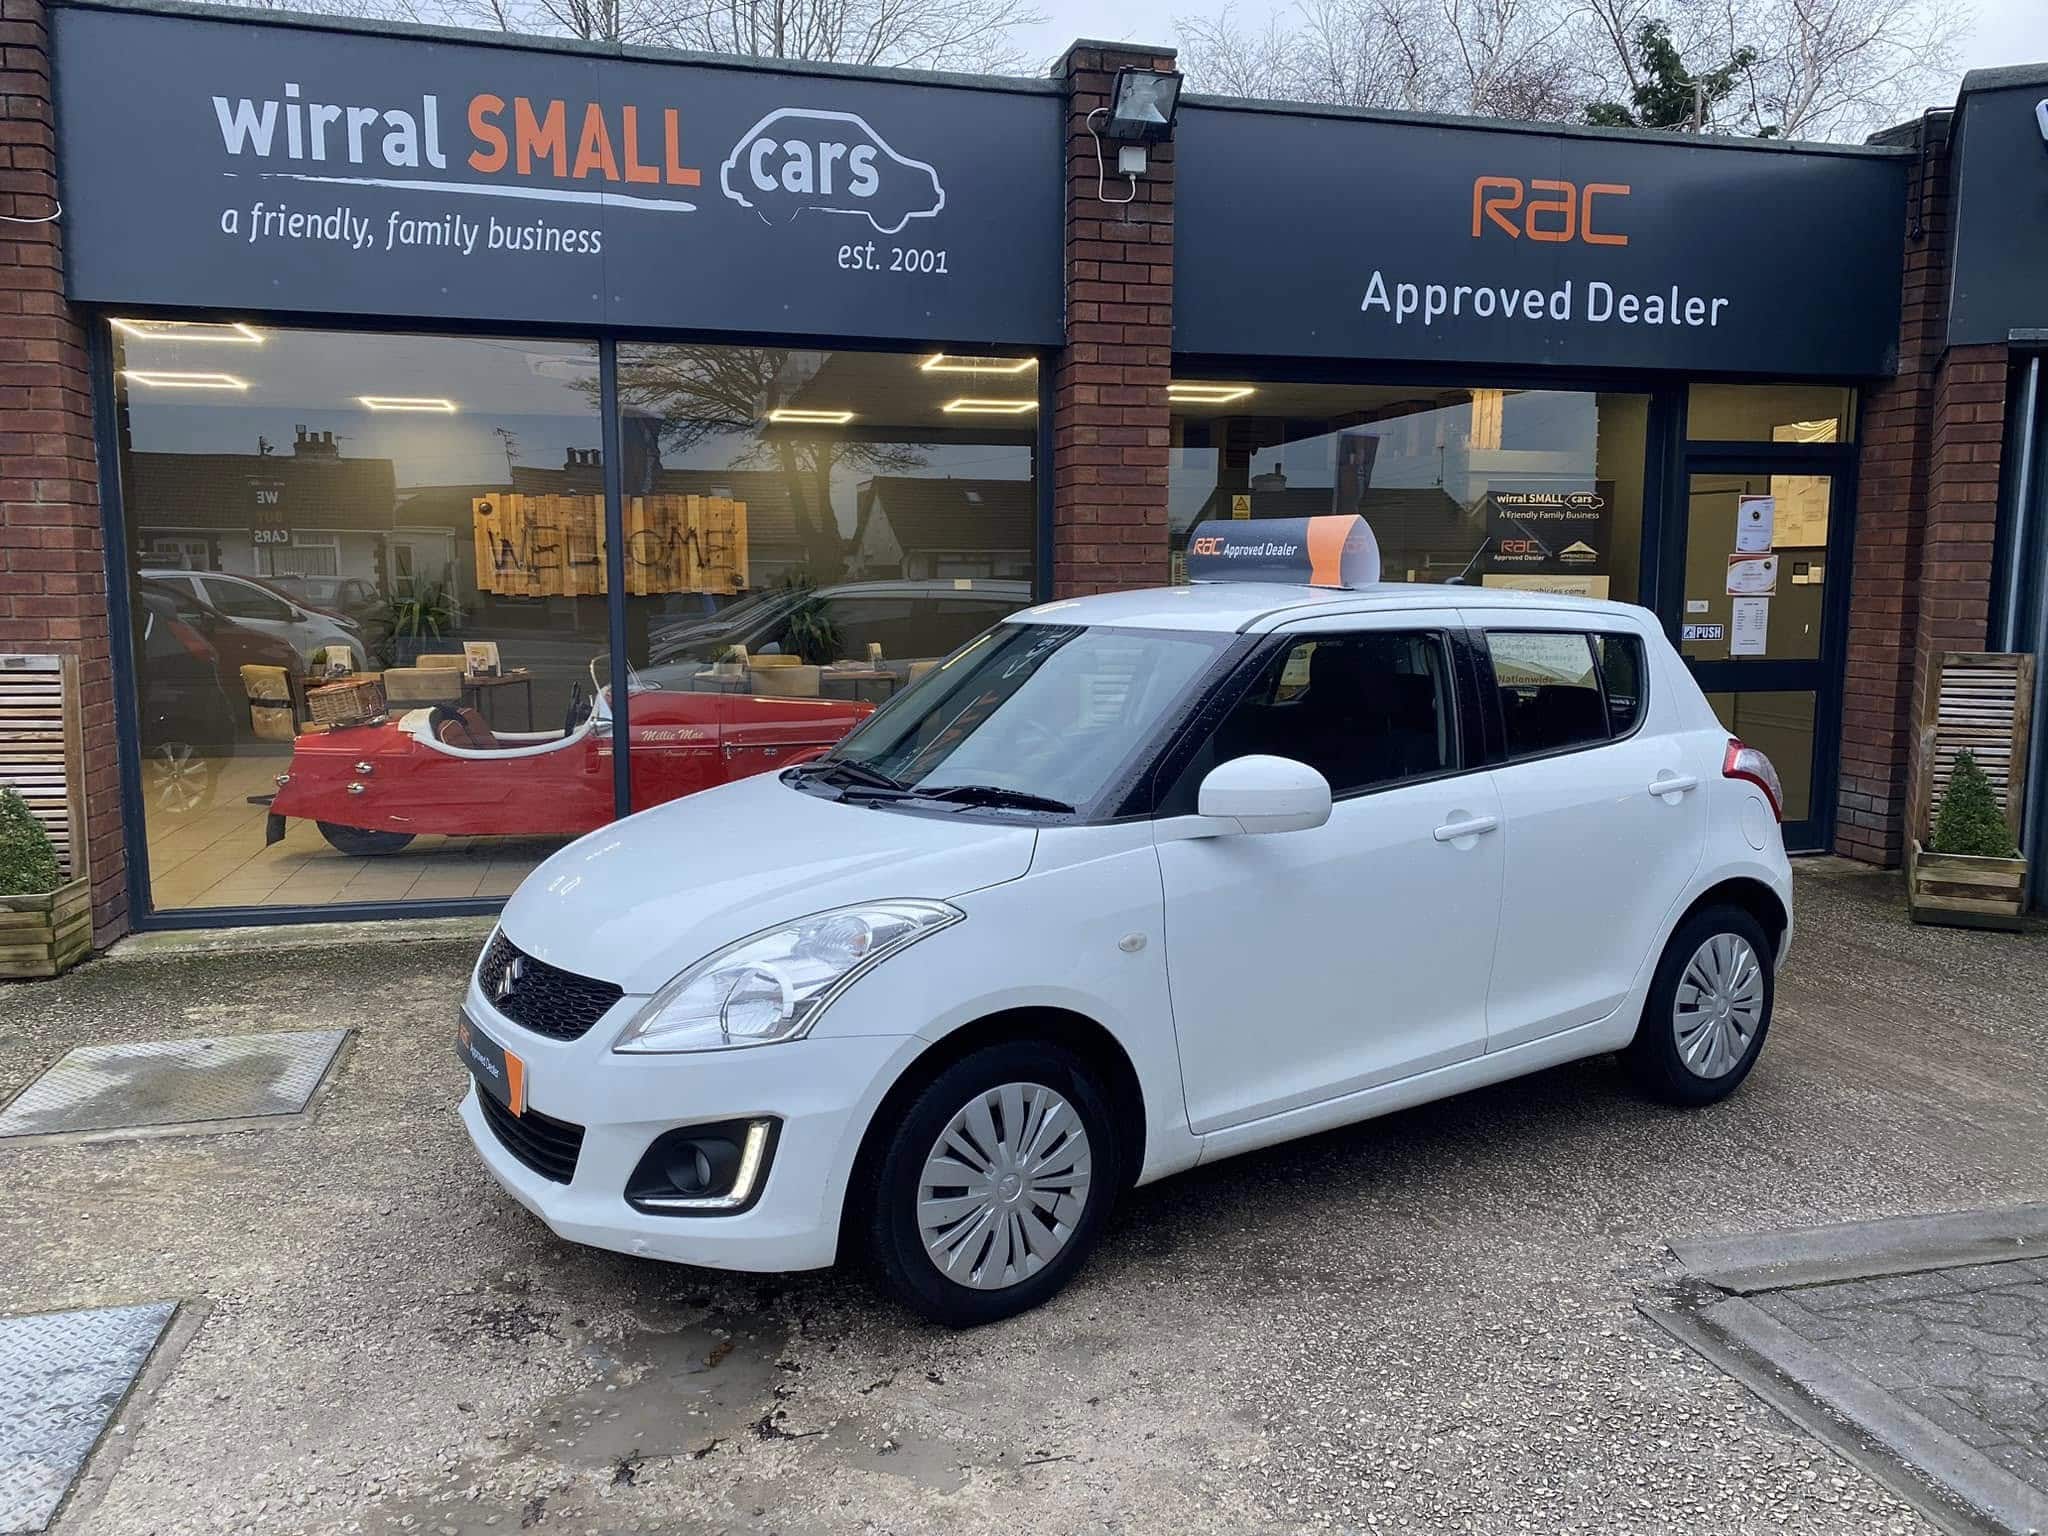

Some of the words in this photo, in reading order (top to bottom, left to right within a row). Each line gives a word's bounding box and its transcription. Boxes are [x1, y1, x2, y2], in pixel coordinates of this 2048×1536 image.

[212, 83, 447, 169] wirral
[467, 94, 701, 187] SMALL
[750, 138, 880, 198] cars
[221, 208, 239, 235] a
[248, 202, 375, 250] friendly,
[386, 210, 480, 256] family
[487, 216, 603, 255] business
[837, 240, 881, 271] est.
[889, 247, 949, 274] 2001
[1361, 269, 1572, 326] Approved
[1587, 279, 1730, 327] Dealer
[1496, 493, 1527, 504] wirral
[1528, 493, 1564, 504] SMALL
[1571, 495, 1593, 504] cars
[1499, 511, 1506, 519] A
[1506, 511, 1538, 520] Friendly
[1539, 511, 1564, 520] Family
[1566, 511, 1600, 520] Business
[1223, 543, 1264, 559] Approved
[1265, 542, 1298, 557] Dealer
[1696, 626, 1722, 638] PUSH
